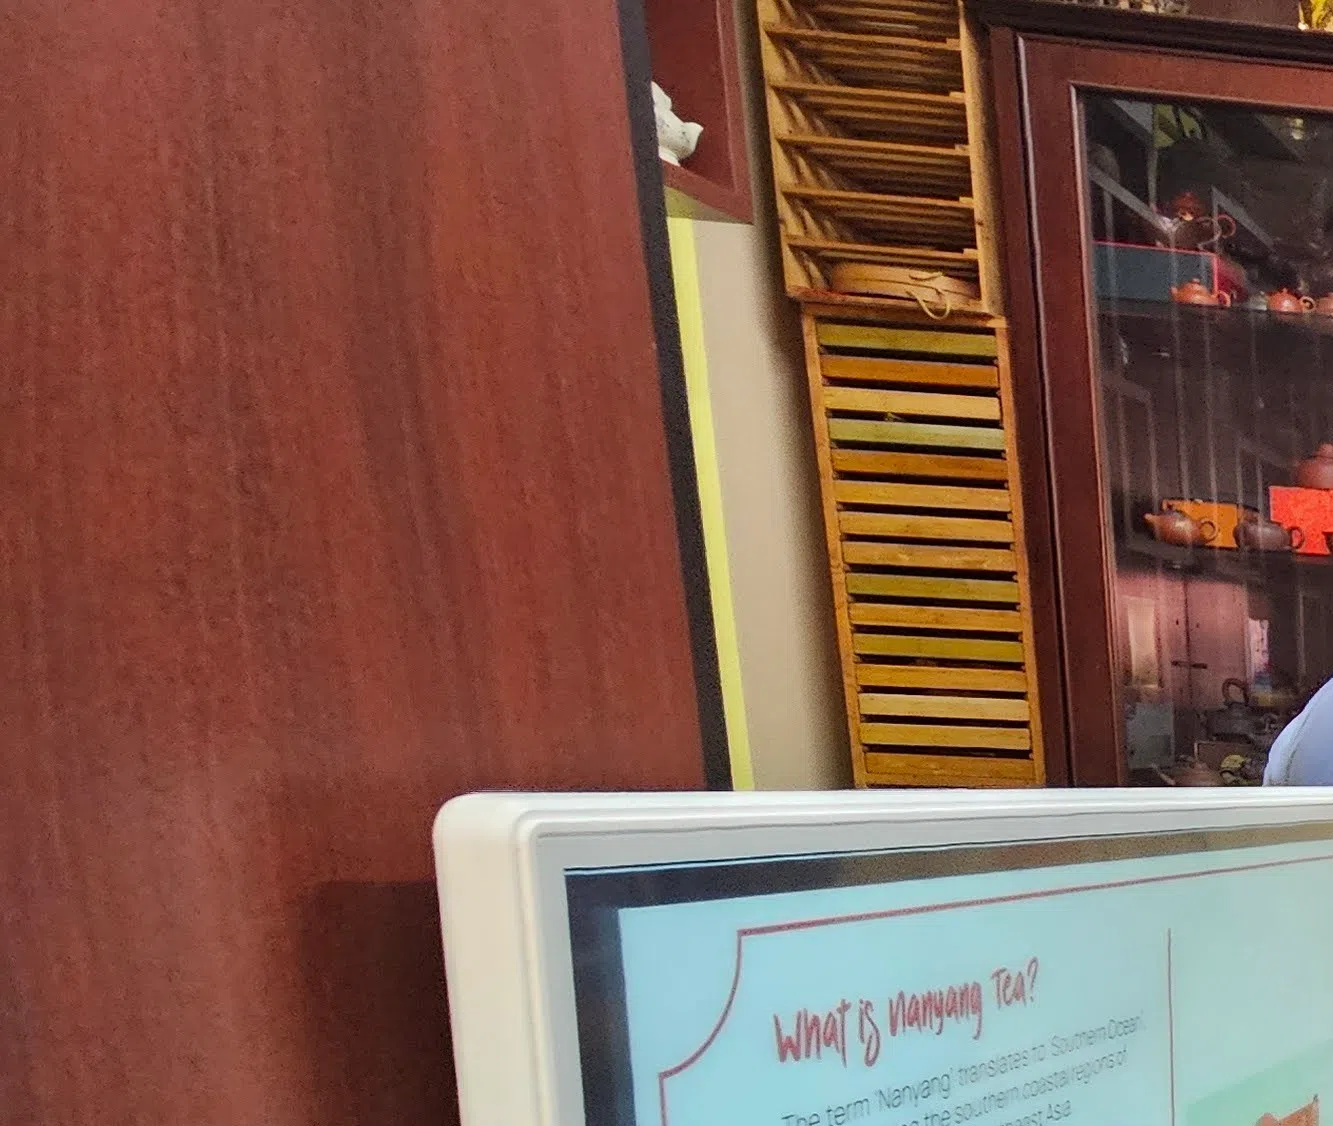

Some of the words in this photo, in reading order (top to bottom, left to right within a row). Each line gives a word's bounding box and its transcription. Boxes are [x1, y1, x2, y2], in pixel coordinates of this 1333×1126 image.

[774, 998, 851, 1068] What
[990, 956, 1039, 1010] Tea?
[954, 1084, 1020, 1125] southern
